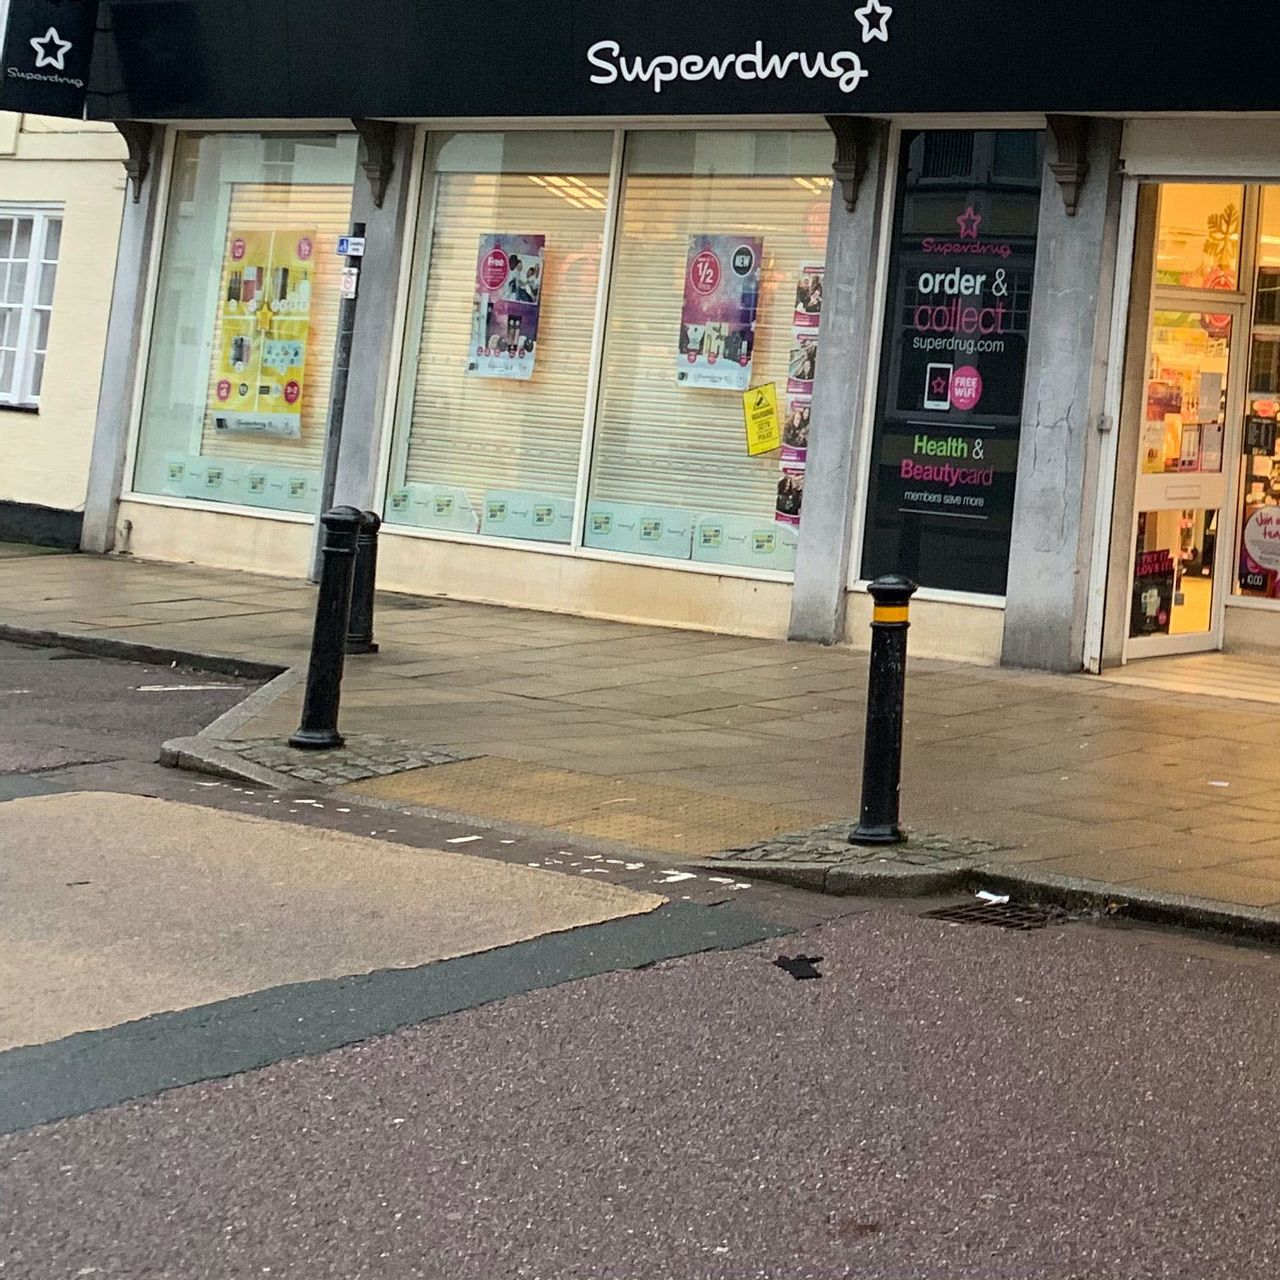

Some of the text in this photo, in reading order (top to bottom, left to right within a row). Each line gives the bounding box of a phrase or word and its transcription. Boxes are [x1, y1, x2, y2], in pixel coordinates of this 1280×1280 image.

[7, 66, 84, 88] Superdrug
[587, 39, 869, 94] Superdrug
[921, 237, 1013, 258] Superdrug
[918, 267, 1008, 297] order &
[914, 297, 1006, 334] collect
[913, 336, 1005, 354] superdrug.com
[955, 376, 978, 387] FREE
[913, 434, 984, 459] Health &
[900, 458, 994, 487] Beautycard
[904, 490, 985, 507] members save more
[1256, 512, 1273, 527] Join
